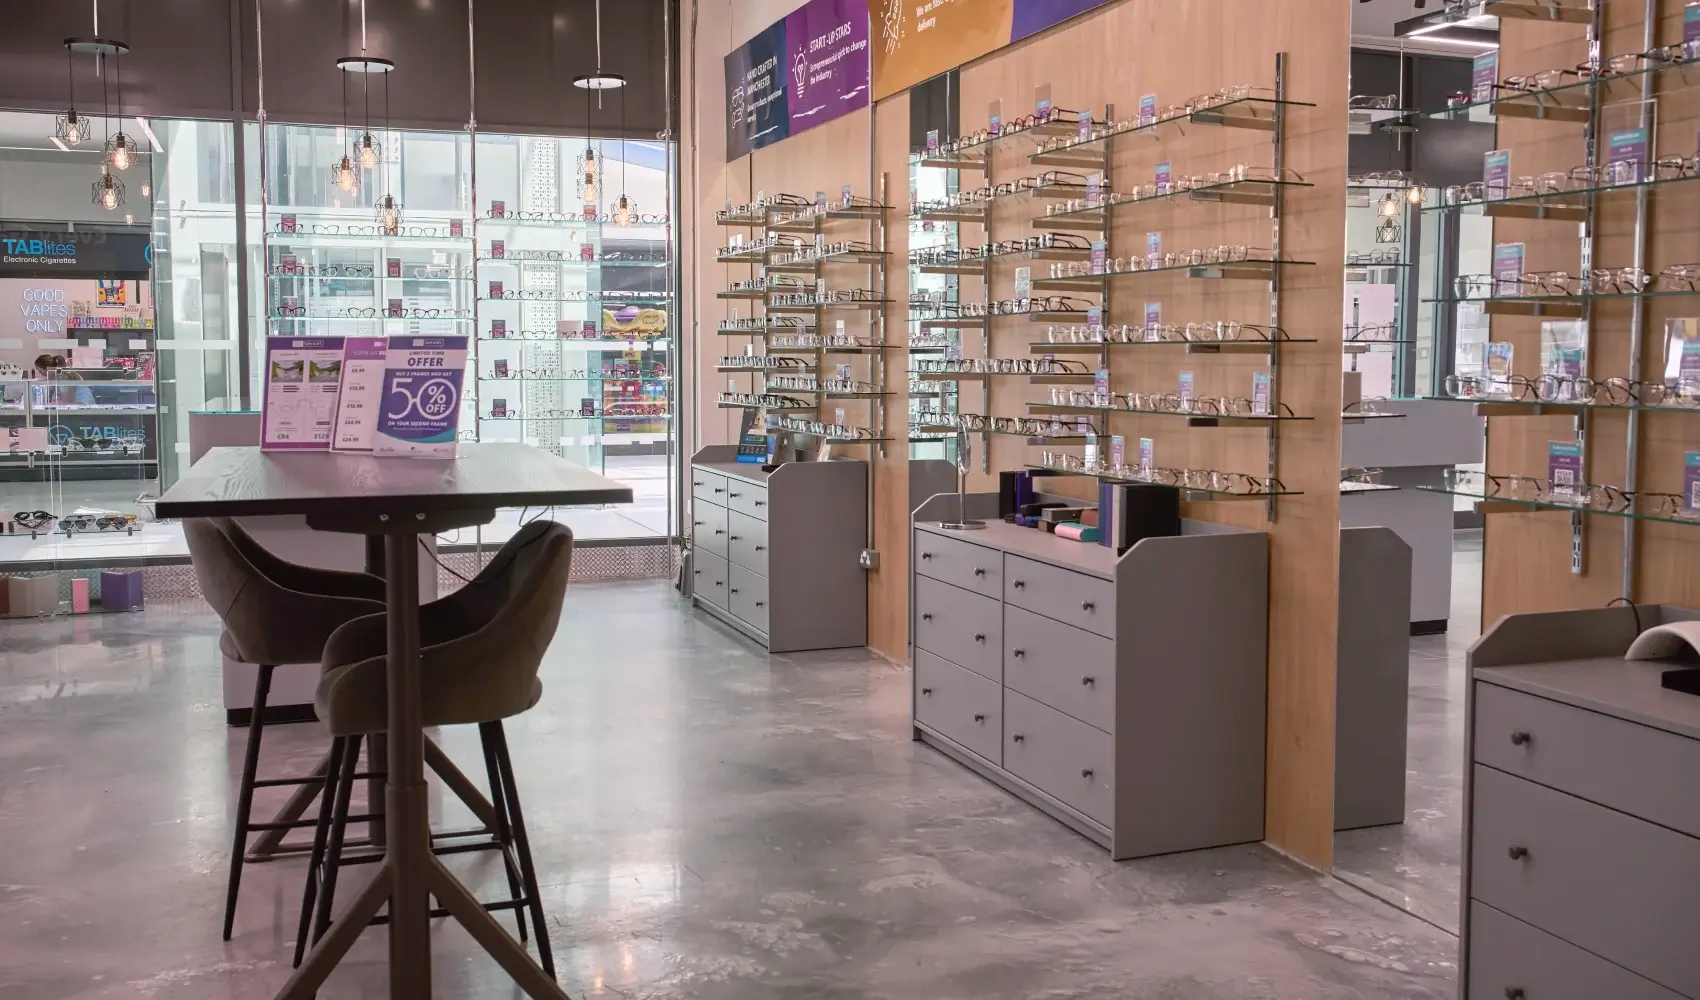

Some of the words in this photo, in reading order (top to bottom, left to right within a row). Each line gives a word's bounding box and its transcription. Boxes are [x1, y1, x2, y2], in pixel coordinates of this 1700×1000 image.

[917, 16, 936, 32] delivery
[810, 32, 835, 53] START-UP
[835, 21, 851, 41] STARS
[845, 46, 850, 54] to
[851, 39, 866, 52] change
[746, 68, 757, 81] HAND
[773, 55, 778, 66] IN
[816, 70, 832, 82] industry
[747, 75, 770, 96] MANCHESTER
[3, 239, 76, 256] TABlites
[40, 256, 76, 265] Cigarettes
[23, 288, 64, 302] GOOD
[20, 304, 68, 318] VAPES
[26, 319, 63, 333] ONLY
[408, 357, 444, 366] OFFER
[388, 378, 457, 420] 50
[425, 403, 446, 414] OFF
[79, 426, 146, 440] TABlites
